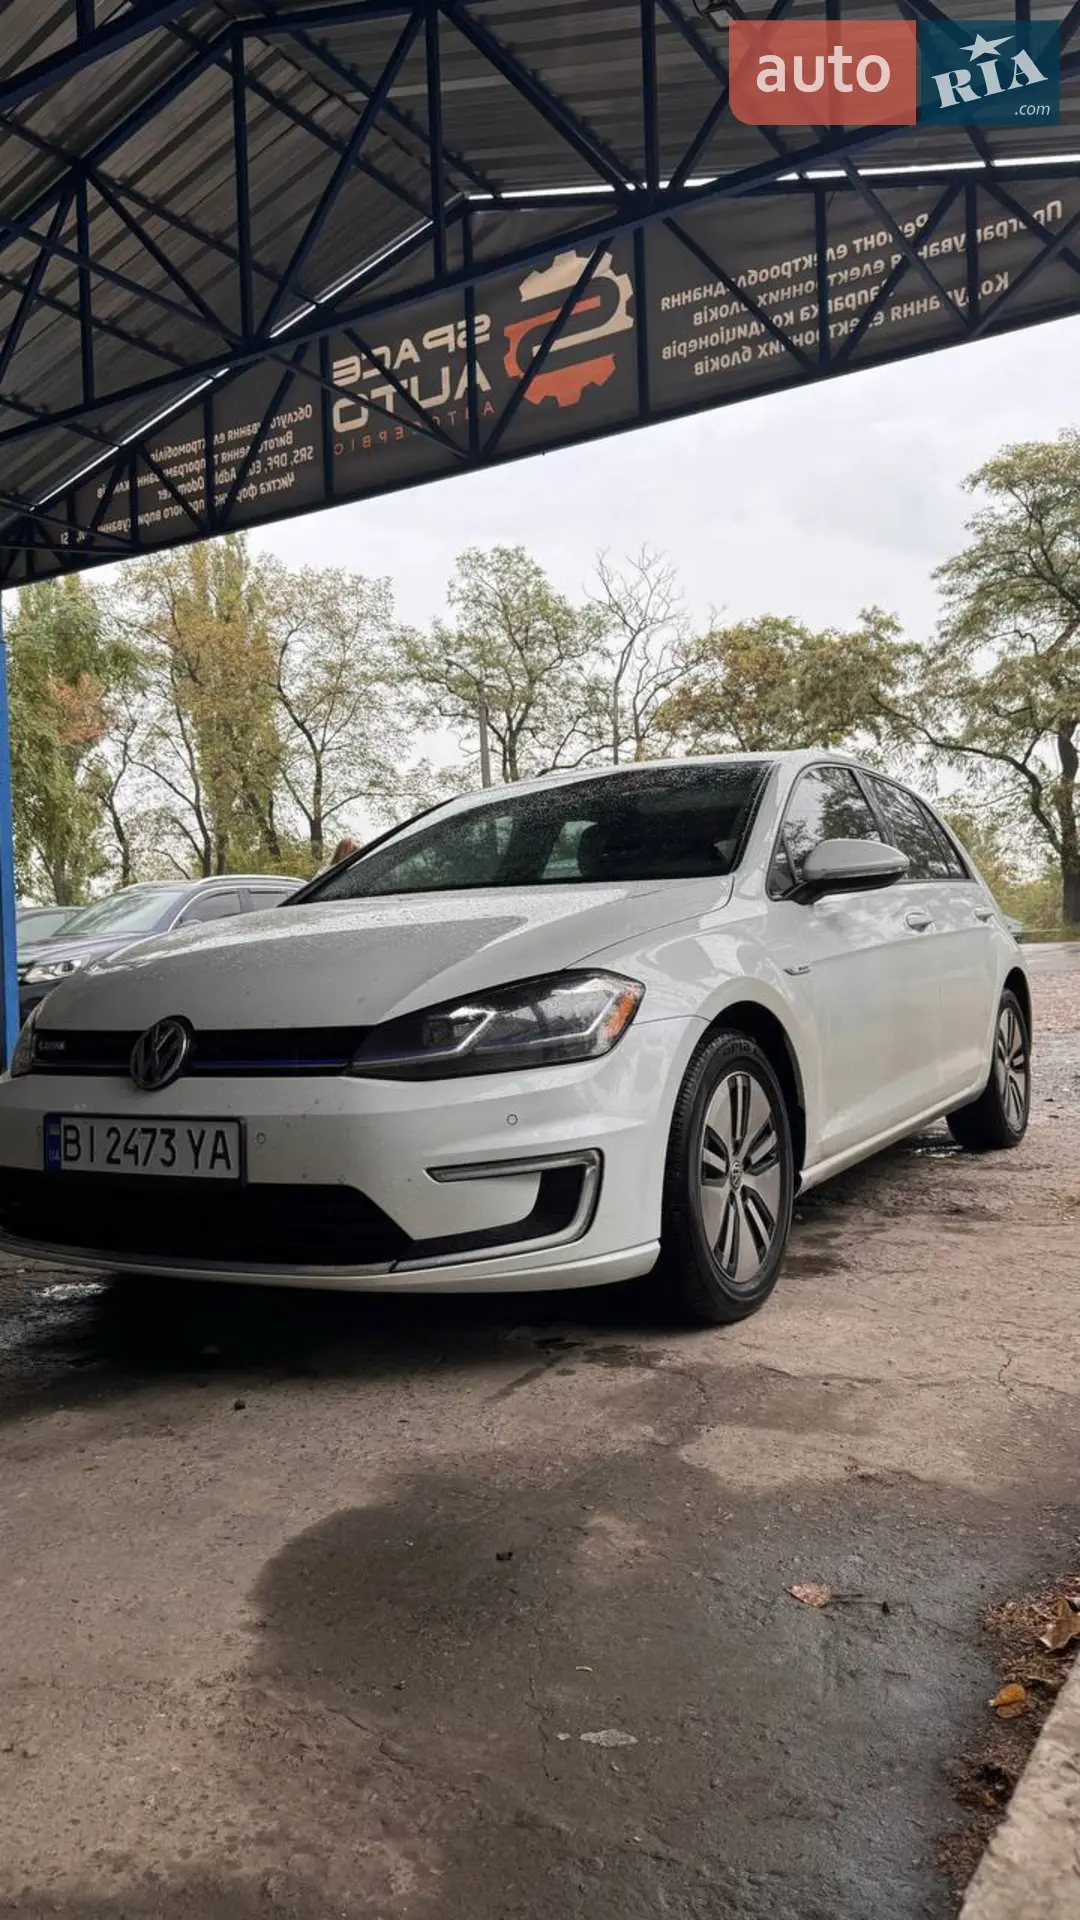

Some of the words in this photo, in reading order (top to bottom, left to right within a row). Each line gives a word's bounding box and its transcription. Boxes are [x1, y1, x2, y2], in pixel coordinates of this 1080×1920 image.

[62, 1124, 95, 1163] BI
[105, 1126, 177, 1168] 2473
[186, 1129, 232, 1170] YA
